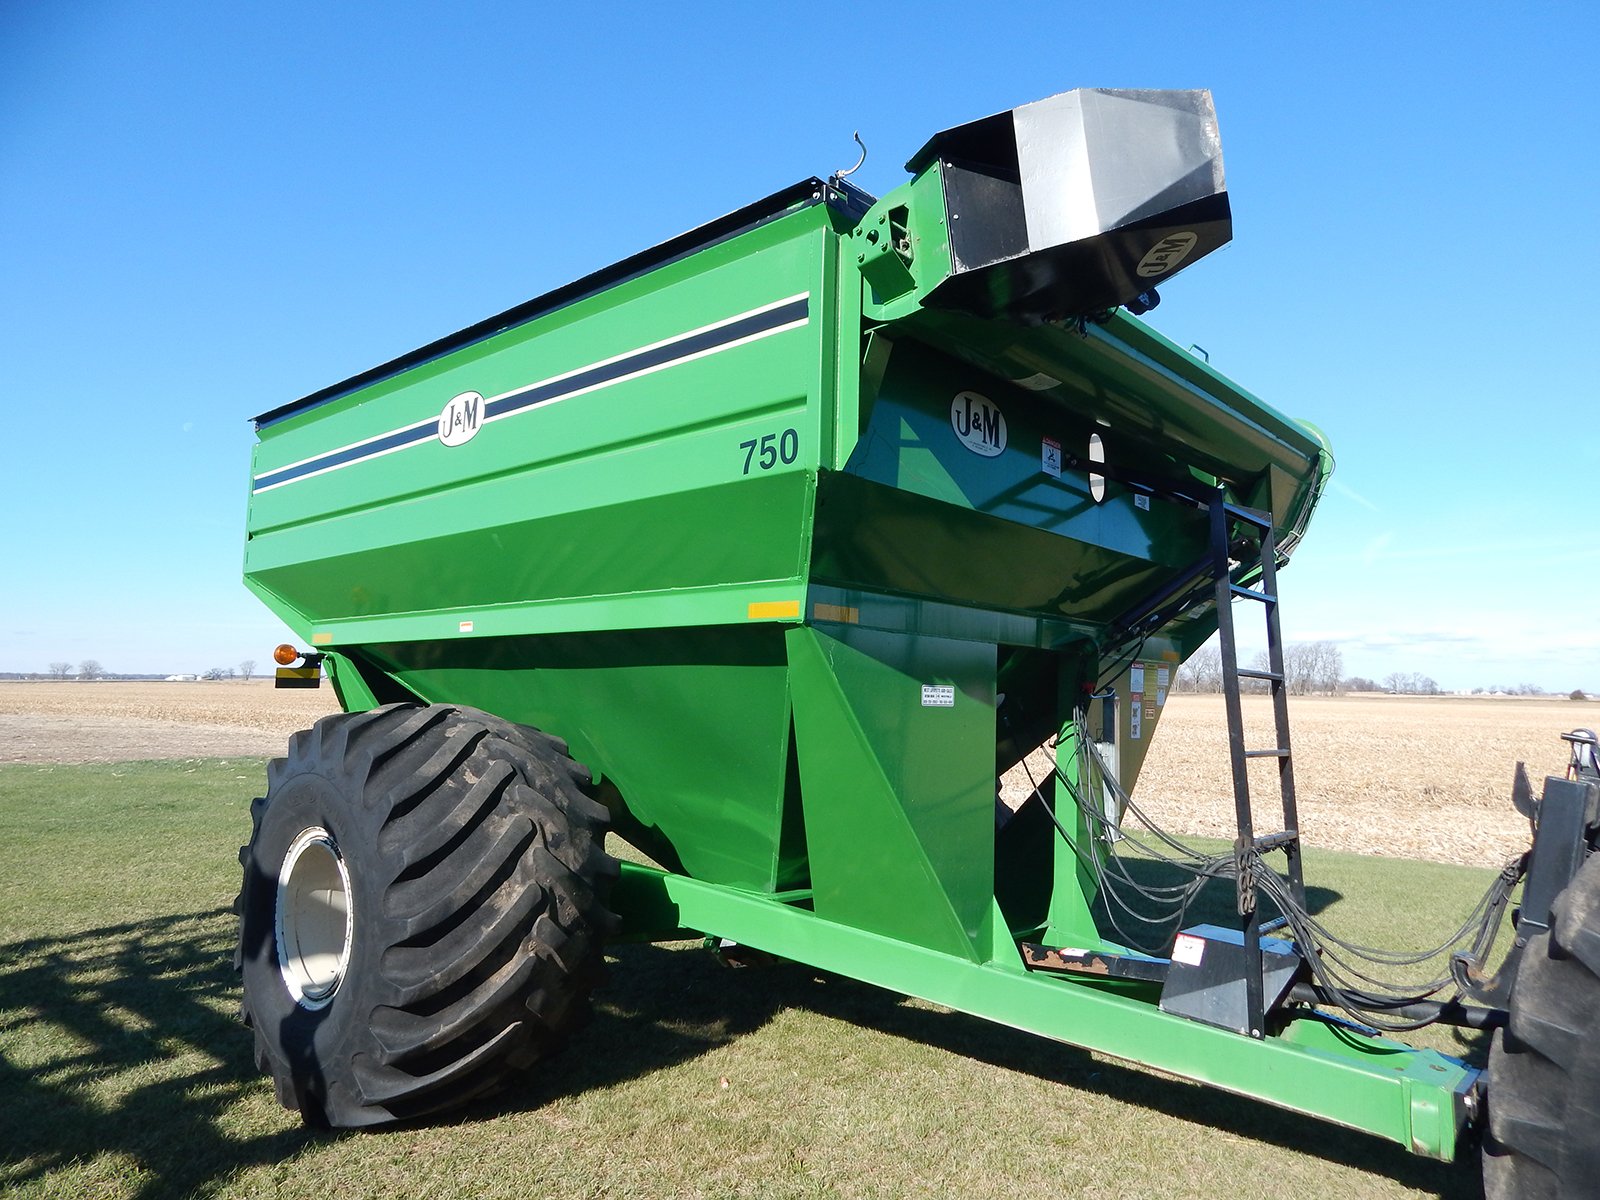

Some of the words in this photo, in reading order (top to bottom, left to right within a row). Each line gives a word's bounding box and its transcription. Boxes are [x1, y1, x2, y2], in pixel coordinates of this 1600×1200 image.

[1141, 237, 1193, 274] J&M
[442, 396, 479, 438] J&M
[955, 396, 1001, 449] J&M
[740, 428, 799, 475] 750
